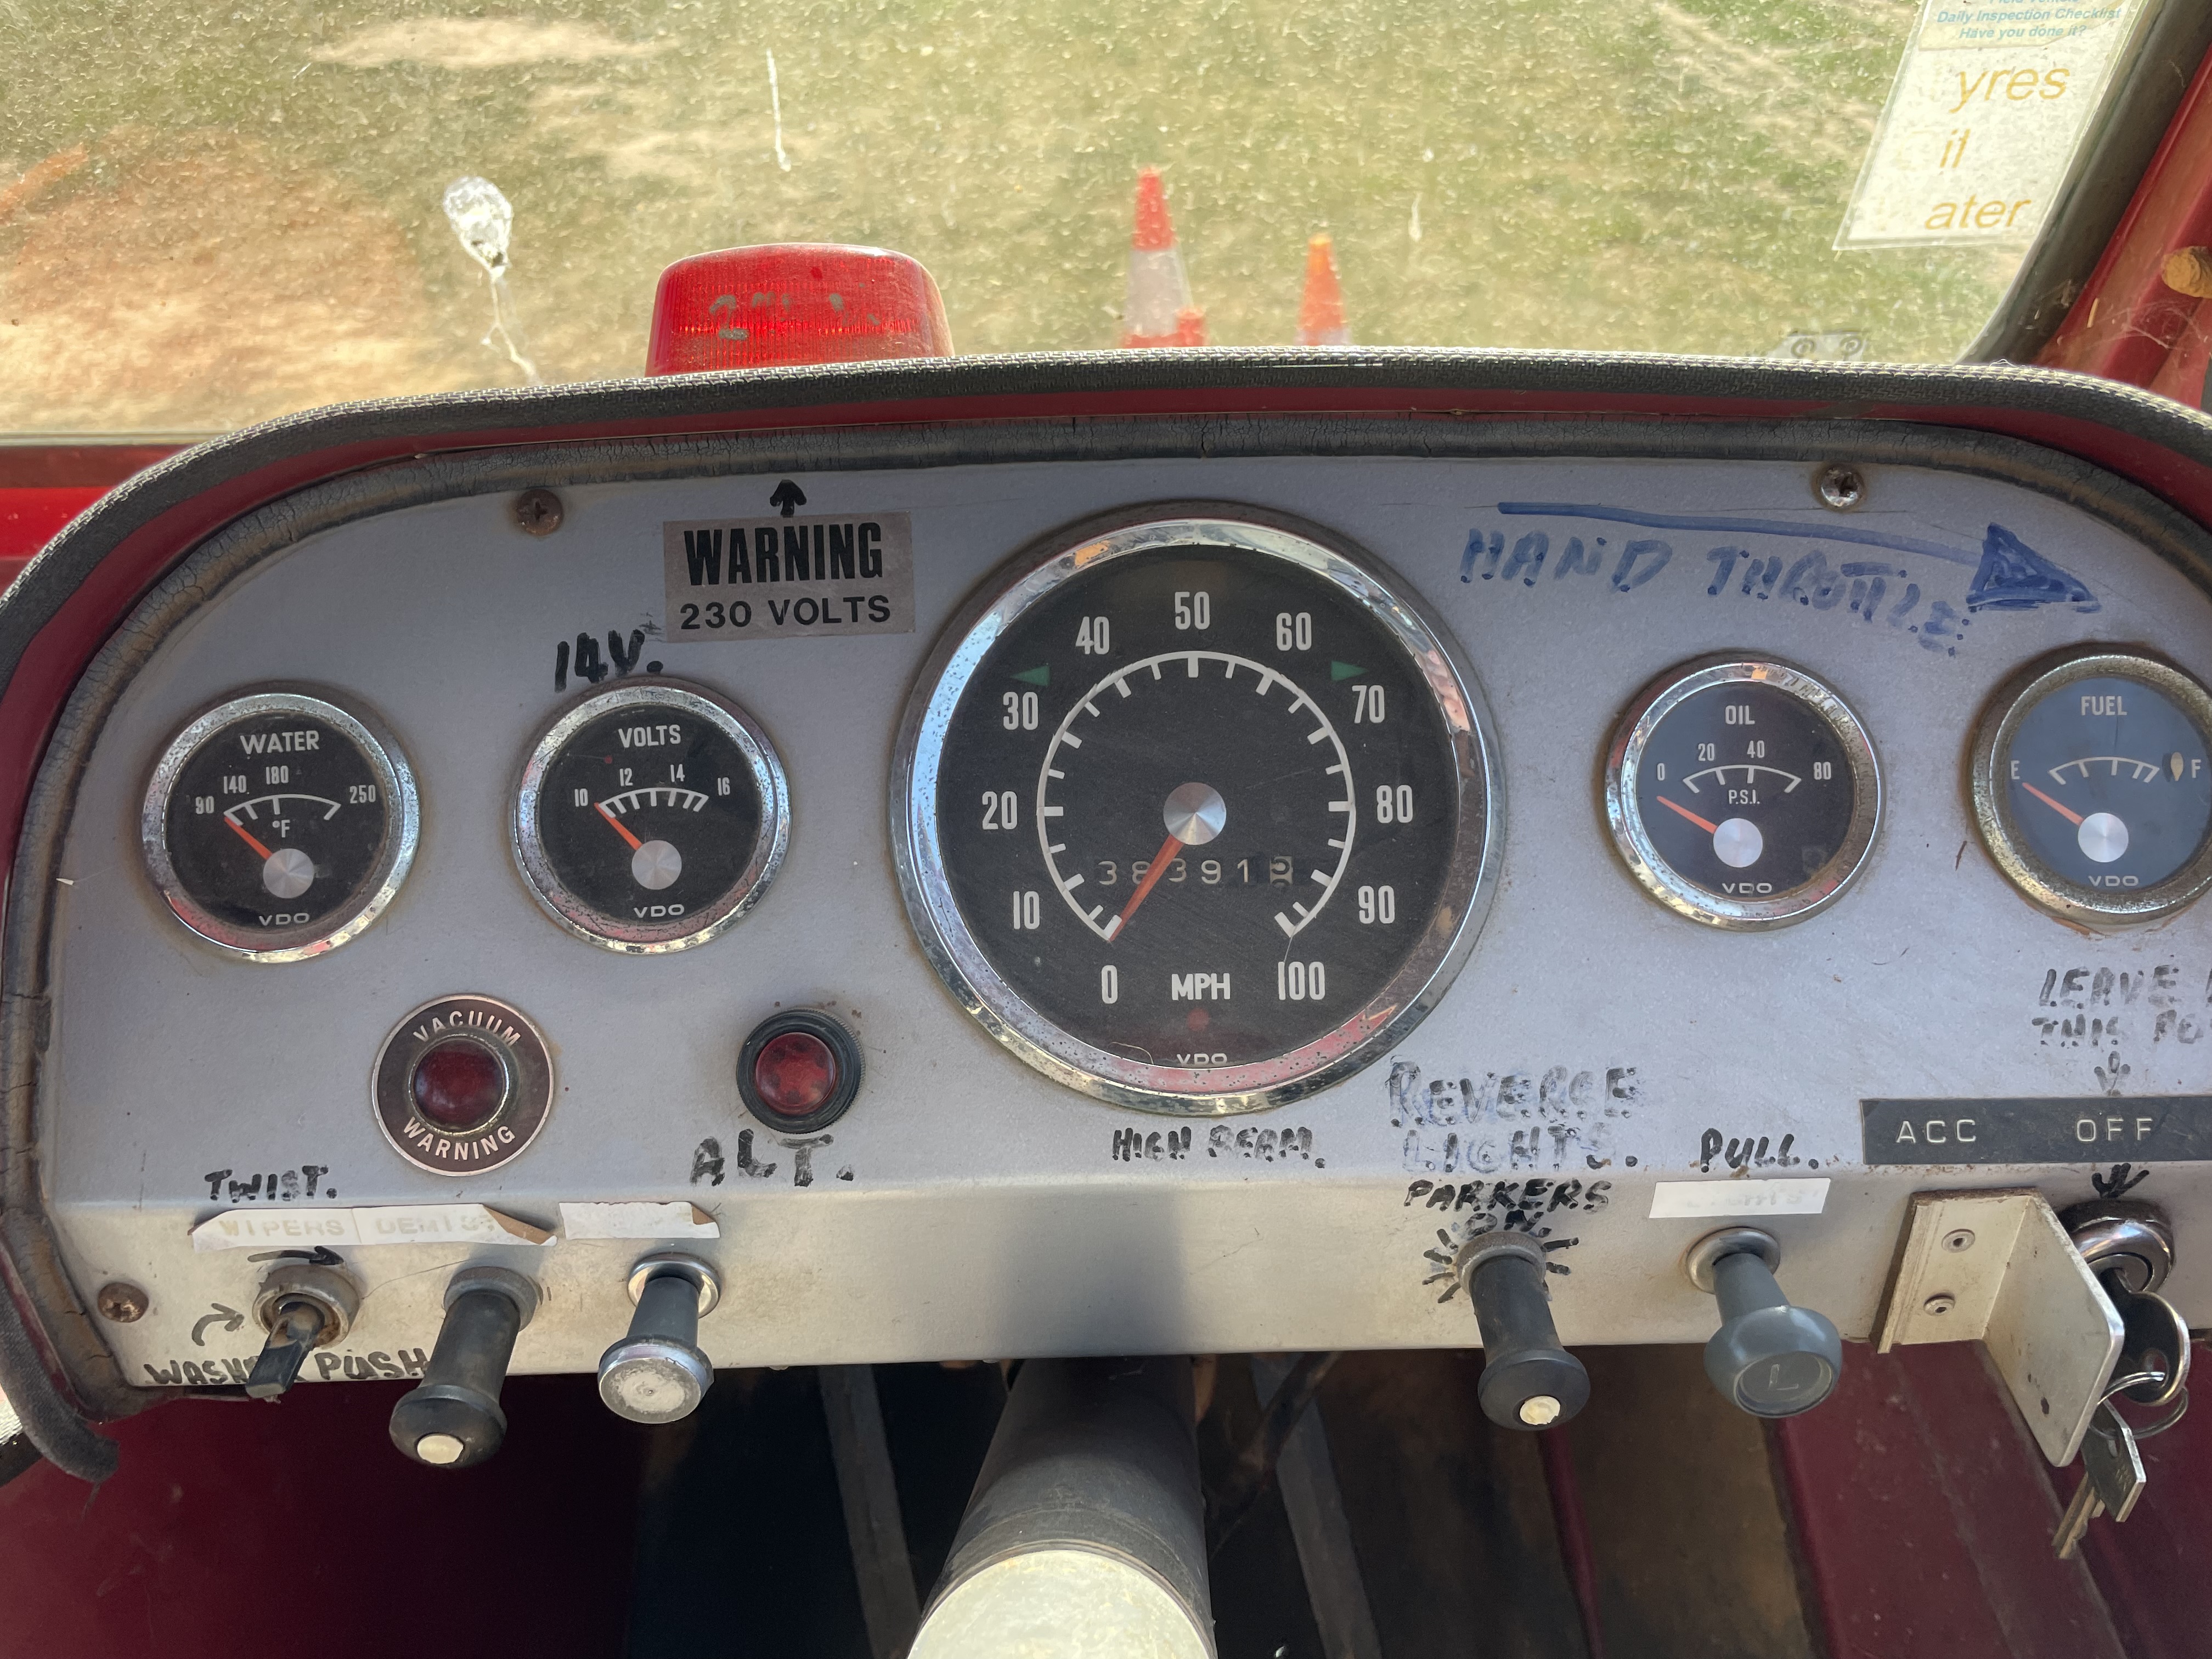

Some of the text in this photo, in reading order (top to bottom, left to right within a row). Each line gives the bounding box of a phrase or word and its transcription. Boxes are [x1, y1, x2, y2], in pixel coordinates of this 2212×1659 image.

[1937, 8, 2122, 24] Daily Inspection Checklist
[1959, 25, 2087, 40] Have you done it?
[684, 522, 883, 586] WARNING
[1460, 527, 1672, 593] HAND
[680, 595, 891, 630] 230 VOLTS
[1175, 591, 1211, 630] 50
[1076, 616, 1110, 655] 40
[1276, 612, 1312, 651] 60
[1002, 691, 1039, 731] 30
[1351, 684, 1385, 724] 70
[1724, 705, 1755, 725] OIL
[2081, 696, 2127, 716] FUEL
[240, 730, 319, 755] WATER
[618, 724, 681, 748] VOLTS
[1657, 740, 1831, 781] 0 20 40 80
[2010, 759, 2202, 780] E F
[195, 765, 376, 815] 90 140 180 250
[574, 764, 730, 807] 10 12 14 16
[1728, 789, 1760, 805] P.S.I.
[982, 791, 1018, 831] 20
[1376, 784, 1413, 824] 80
[1722, 882, 1773, 894] VDO
[2088, 876, 2138, 887] VDO
[258, 912, 310, 926] VDO
[633, 904, 685, 918] VDO
[1013, 890, 1040, 930] 10
[1358, 885, 1395, 925] 90
[1101, 964, 1118, 1005] 0
[1171, 973, 1231, 1001] MPH
[1277, 961, 1325, 1001] 100
[413, 1010, 521, 1047] VACUUM
[1176, 1053, 1227, 1066] VDO
[403, 1115, 516, 1161] WARNING
[1895, 1117, 2153, 1144] ACC OFF
[1404, 1178, 1612, 1214] PARKERS
[219, 1218, 346, 1237] WIPERS
[314, 1348, 431, 1380] PUSH
